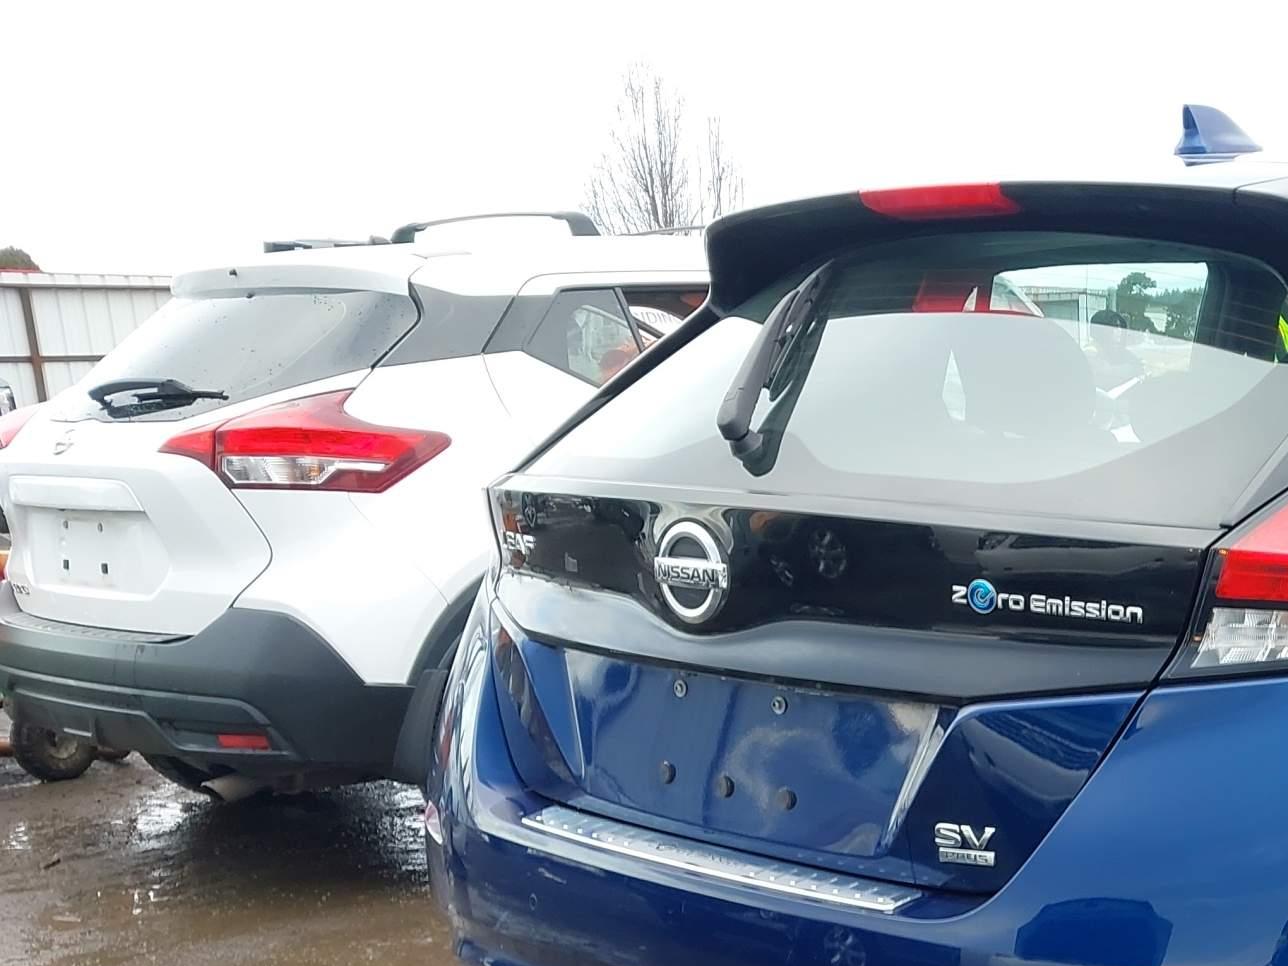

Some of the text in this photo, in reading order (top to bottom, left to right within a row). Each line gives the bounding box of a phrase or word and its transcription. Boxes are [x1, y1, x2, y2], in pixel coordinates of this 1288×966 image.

[657, 561, 715, 583] NISSAN
[1029, 594, 1144, 625] Emission
[934, 822, 996, 850] SV
